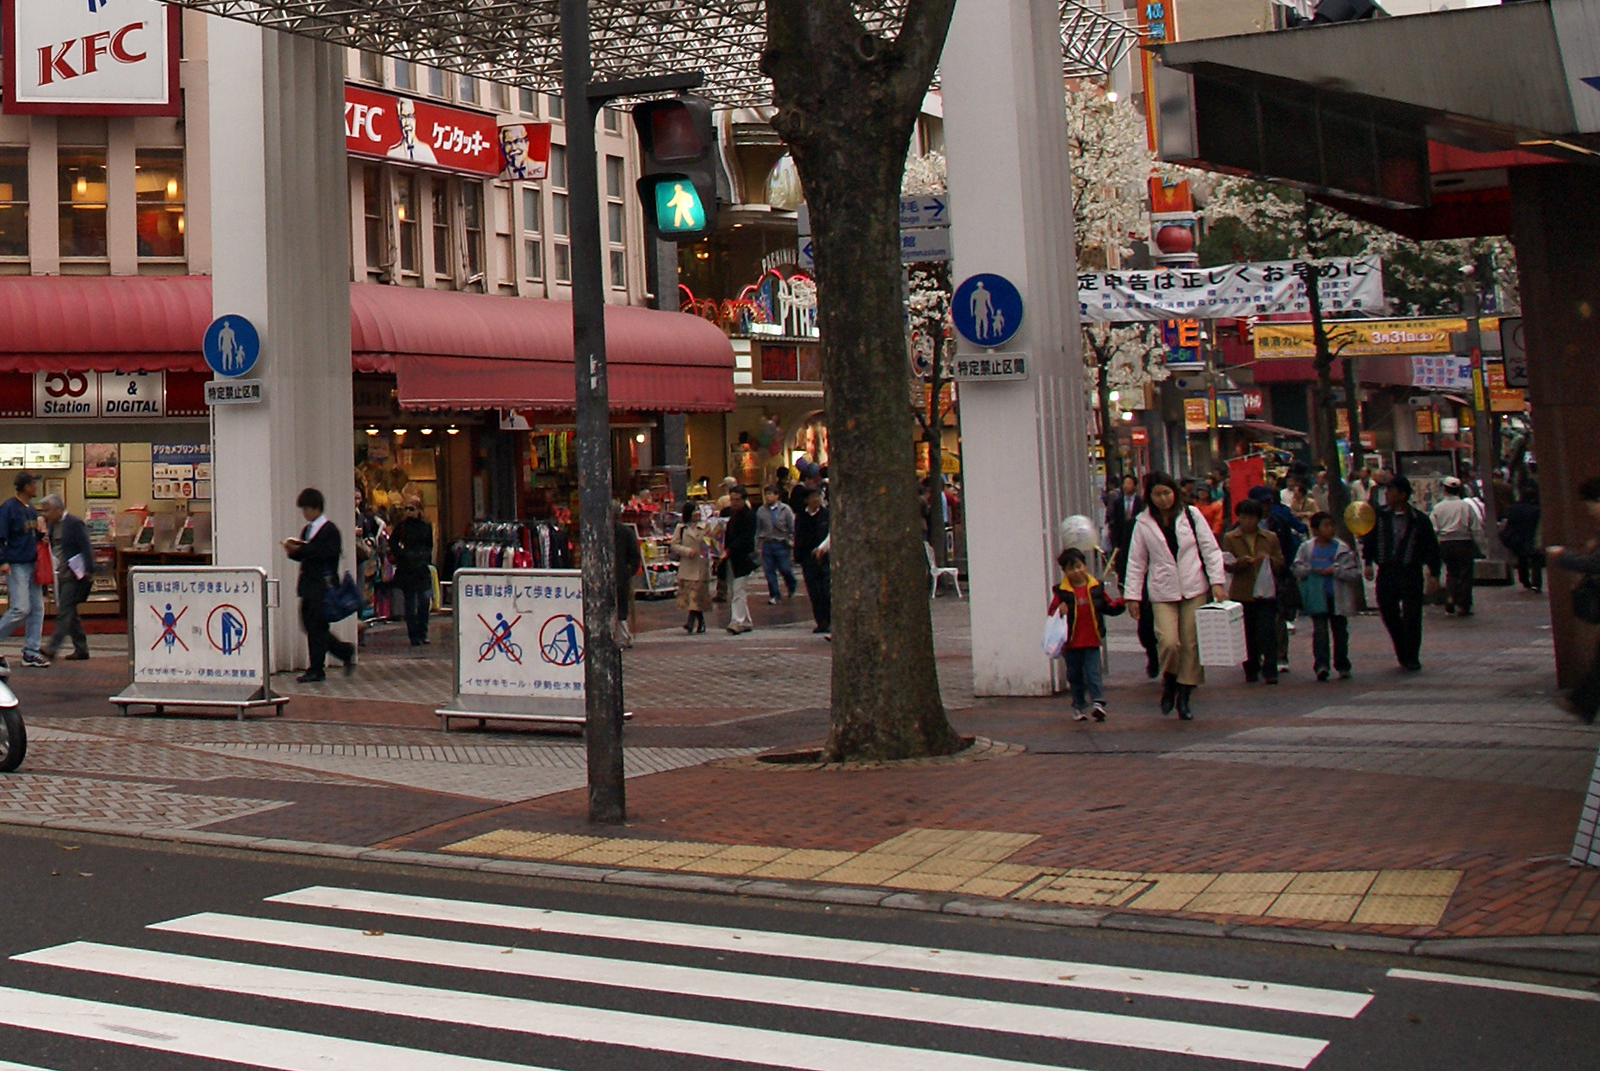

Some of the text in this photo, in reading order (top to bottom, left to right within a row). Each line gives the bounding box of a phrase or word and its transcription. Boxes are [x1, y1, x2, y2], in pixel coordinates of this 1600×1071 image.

[37, 21, 148, 87] KFC
[432, 121, 491, 157] ケンタッキー
[957, 357, 1025, 377] 特定禁止区間
[127, 380, 138, 396] &
[208, 384, 260, 400] 特定禁止区間
[43, 400, 91, 414] Station
[105, 400, 159, 413] DIGITAL
